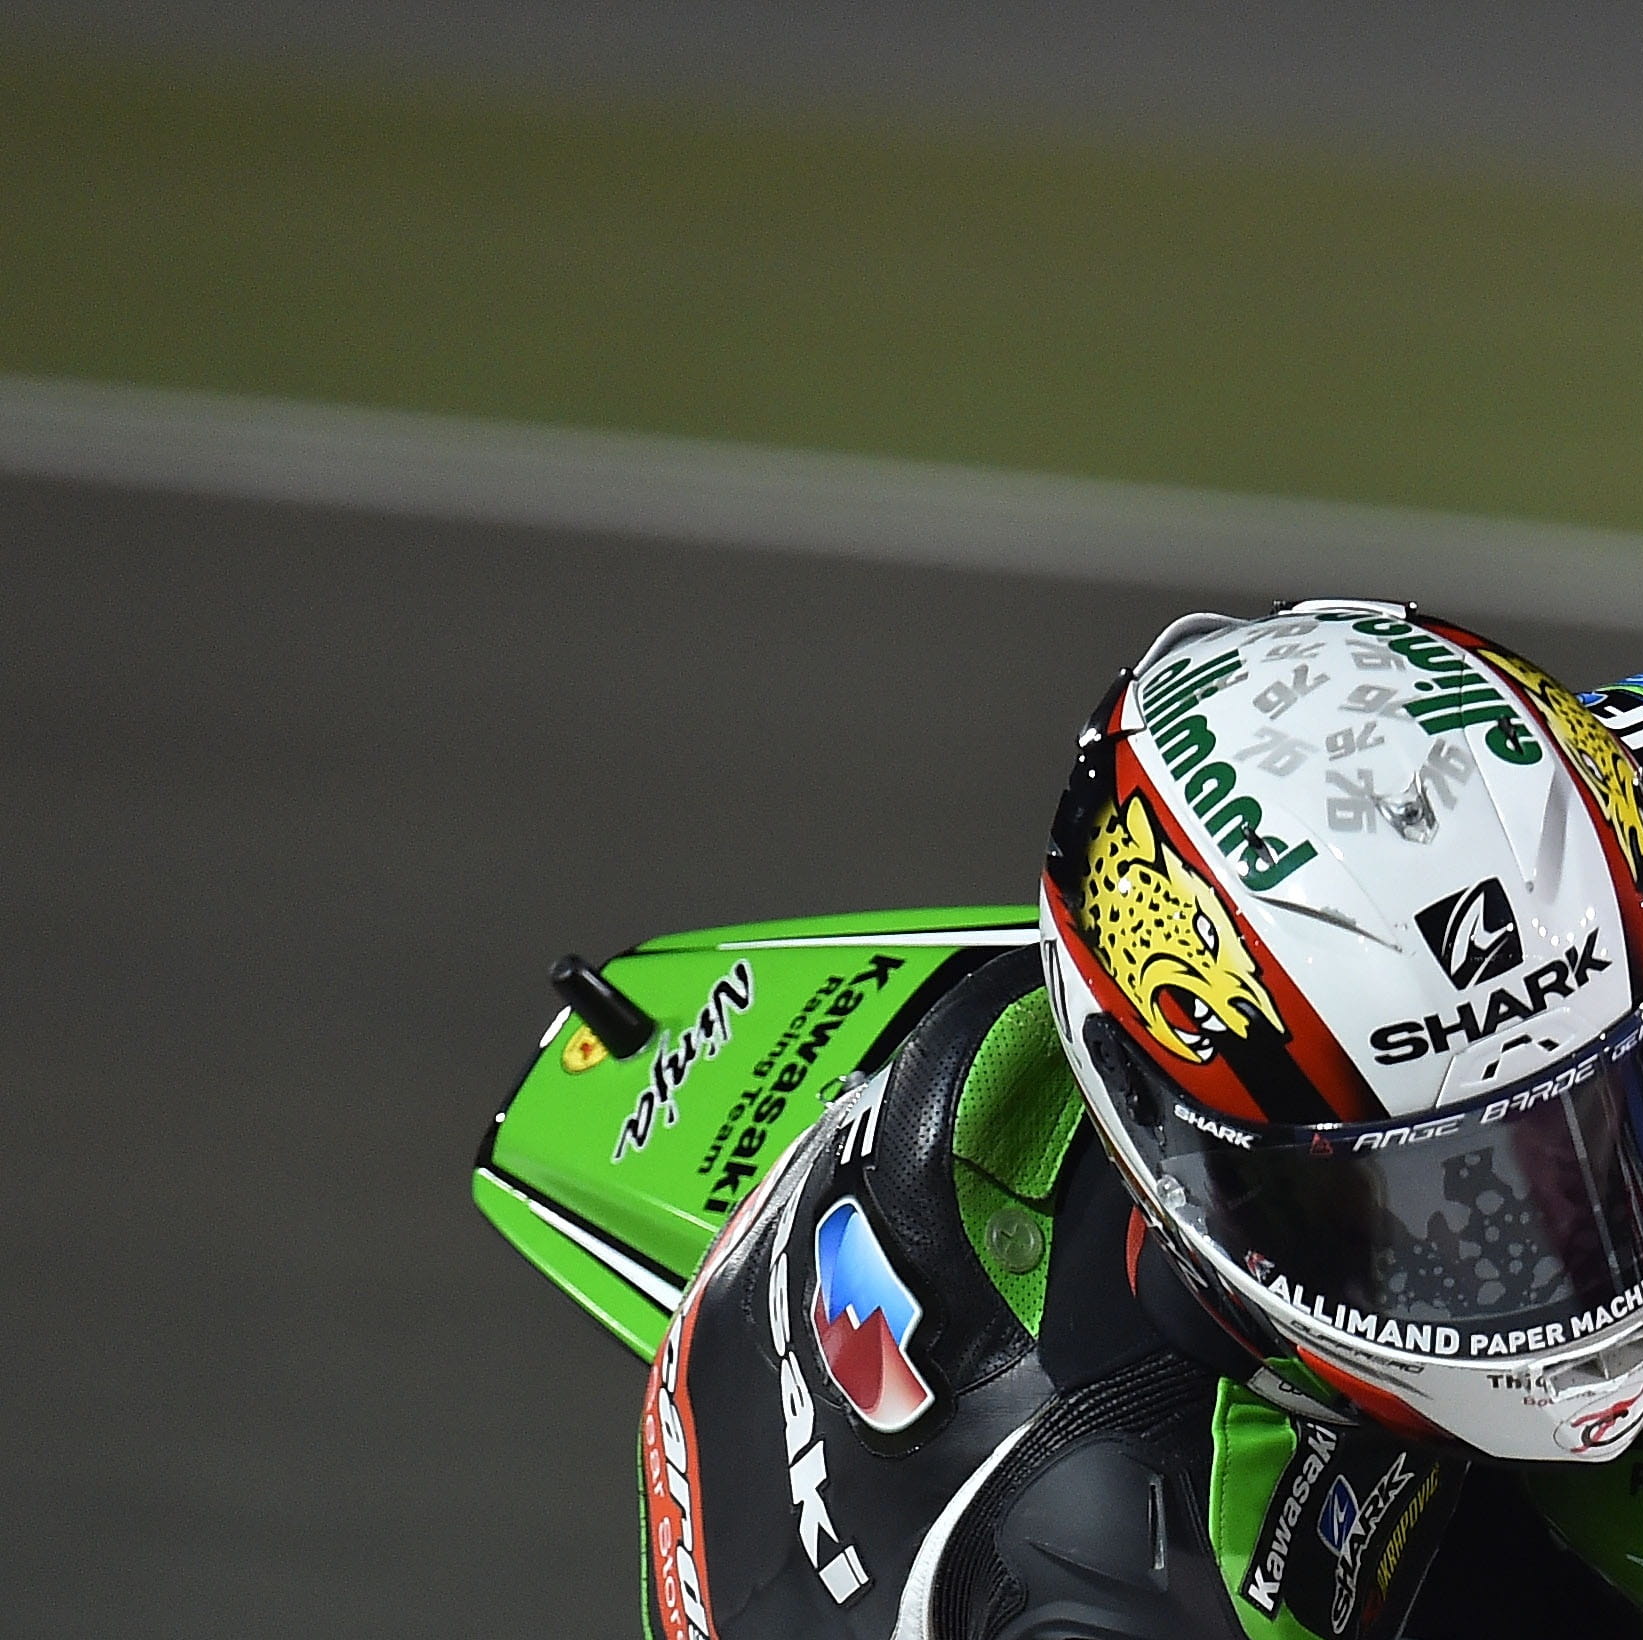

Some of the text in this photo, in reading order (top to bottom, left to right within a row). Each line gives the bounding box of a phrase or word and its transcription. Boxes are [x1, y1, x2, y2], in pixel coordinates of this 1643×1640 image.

[611, 959, 755, 1163] Ninja
[697, 974, 845, 1175] Racing Team
[702, 954, 906, 1214] Kawasaki
[1369, 928, 1613, 1065] SHARK
[1174, 1104, 1254, 1149] SHARK
[1268, 1274, 1460, 1354] ALLIMAND
[1471, 1323, 1566, 1356] PAPER
[1248, 1423, 1338, 1611] Kawasaki
